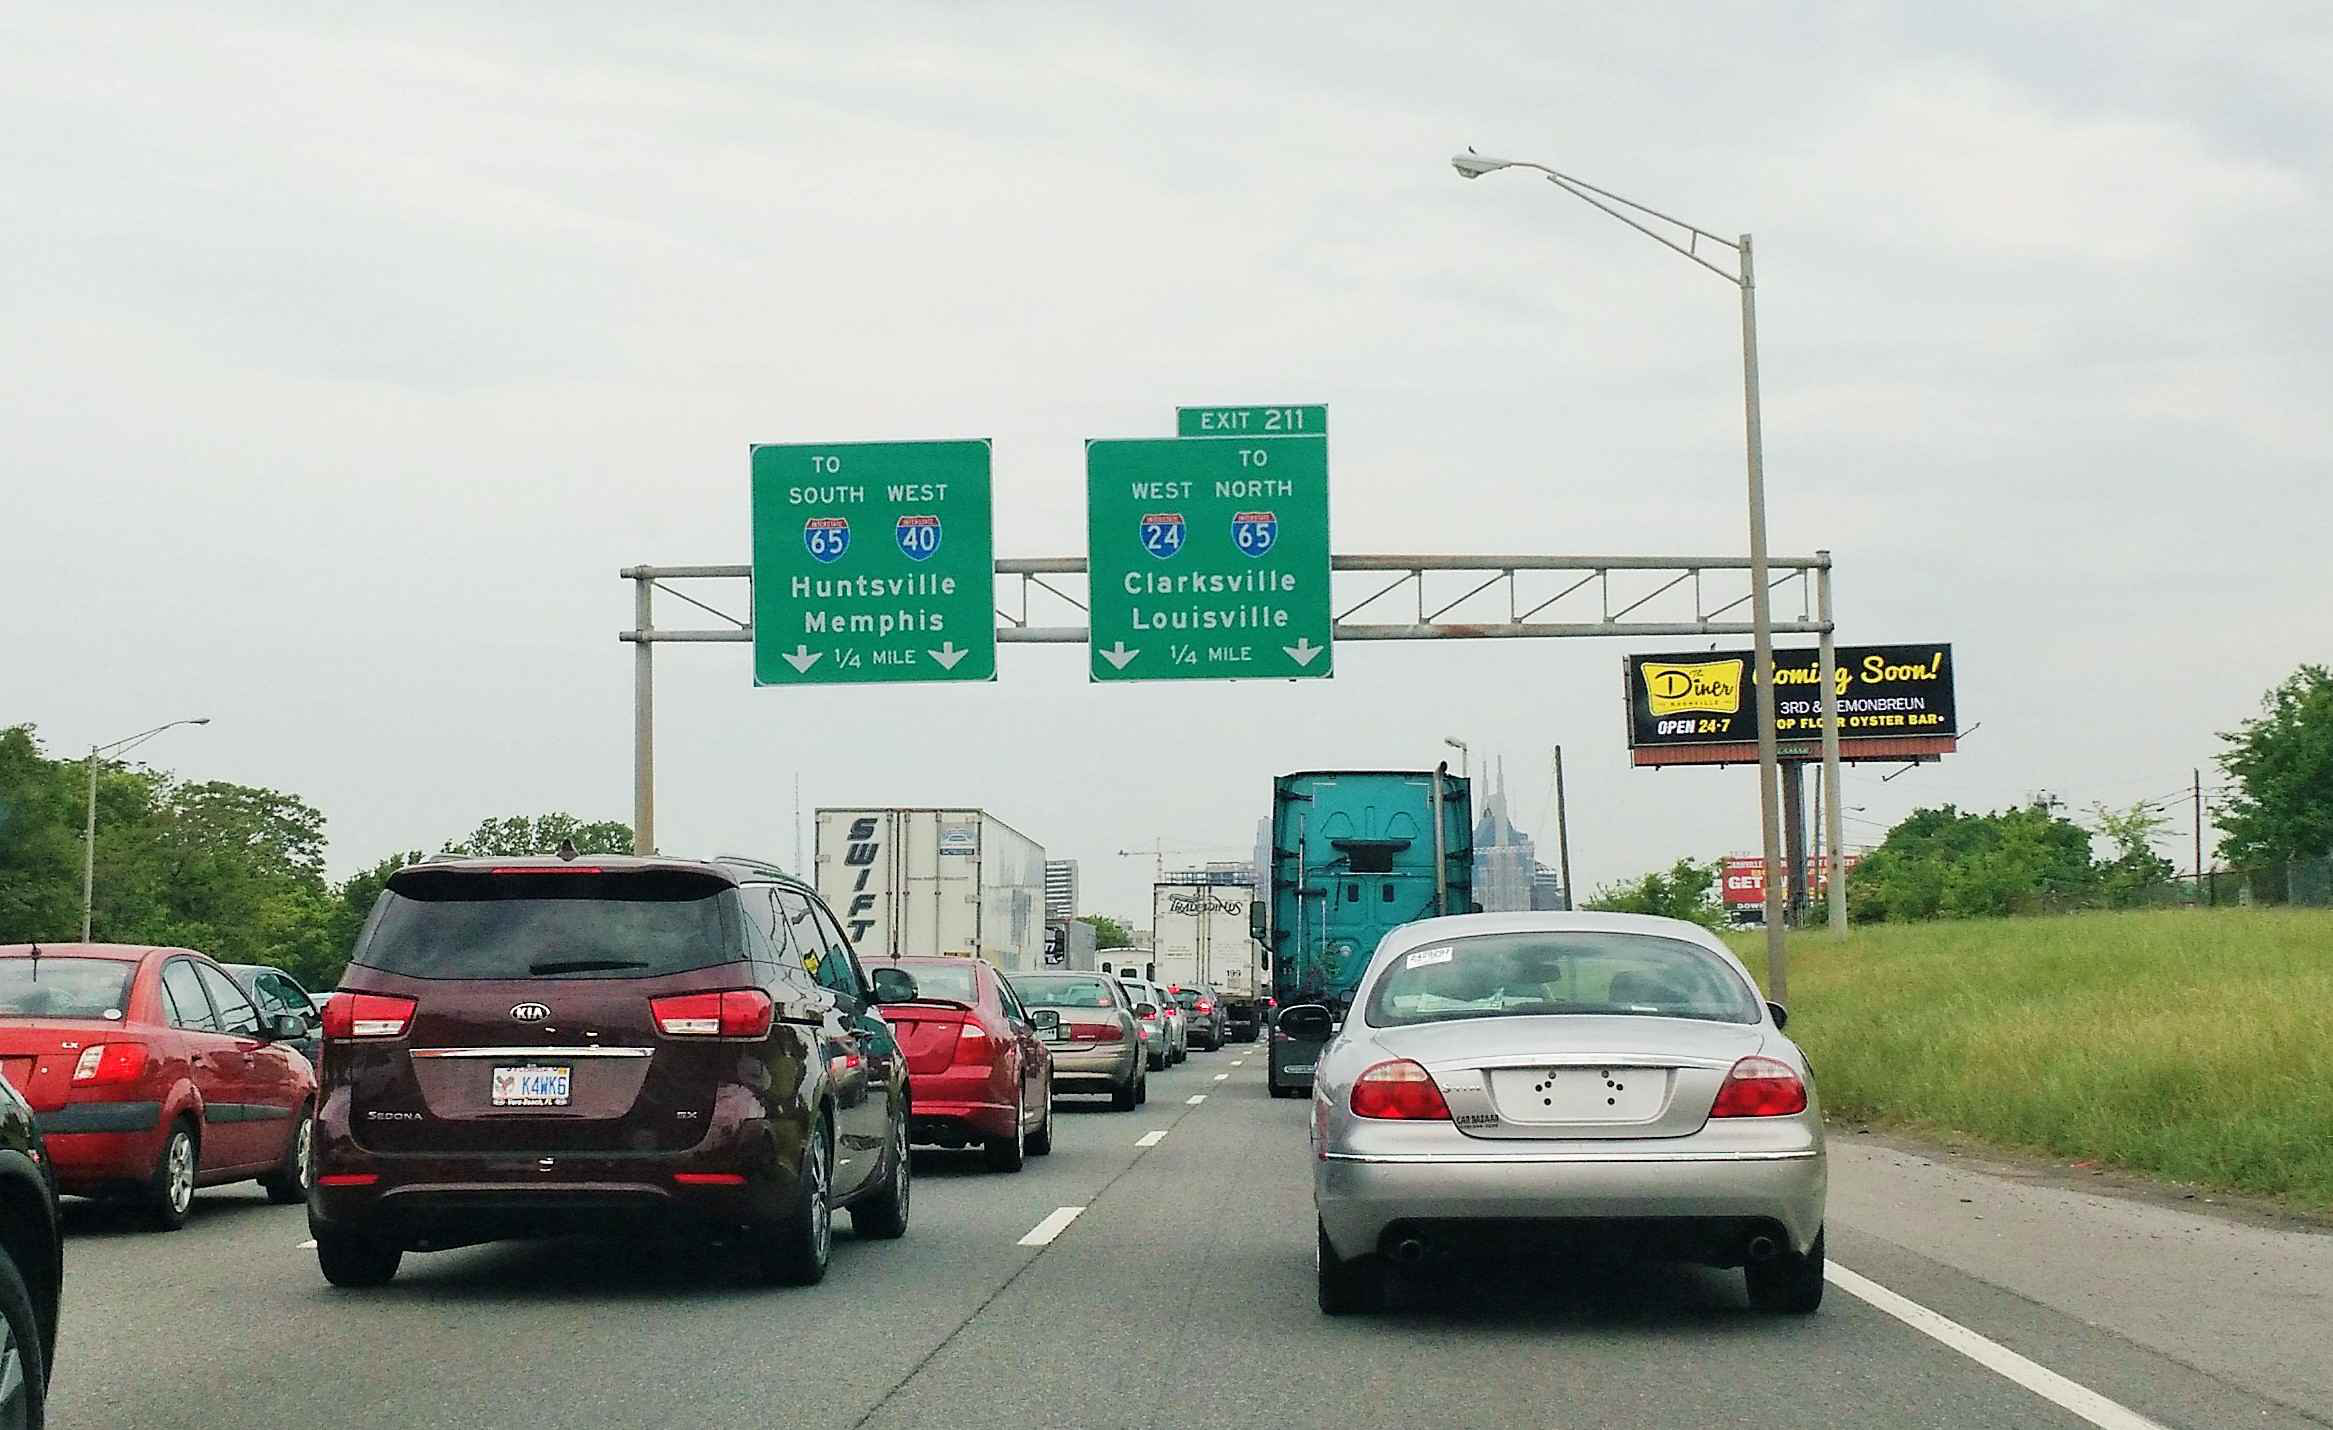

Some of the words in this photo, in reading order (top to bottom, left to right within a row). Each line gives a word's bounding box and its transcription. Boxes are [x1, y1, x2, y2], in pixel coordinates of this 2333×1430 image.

[1201, 412, 1250, 430] EXIT
[1264, 409, 1304, 430] 211
[812, 456, 841, 473] TO
[1238, 450, 1268, 467] TO
[789, 485, 865, 504] SOUTH
[887, 484, 948, 502] WEST
[1132, 481, 1192, 499] WEST
[1215, 480, 1293, 498] NORTH
[811, 529, 844, 554] 65
[903, 526, 935, 551] 40
[1147, 524, 1180, 550] 24
[1238, 523, 1271, 548] 65
[791, 574, 957, 598] Huntsville
[1123, 570, 1297, 595] Clarksville
[804, 608, 945, 637] Memphis
[1132, 606, 1289, 630] Louisville
[872, 650, 916, 665] MILE
[1208, 647, 1253, 662] MILE
[1861, 652, 1942, 684] Soon!
[1655, 670, 1734, 699] Diner
[1780, 701, 1810, 715] 3RD
[1836, 697, 1926, 713] EMONBREUN
[1657, 720, 1696, 735] OPEN
[1776, 717, 1796, 730] OP
[1800, 716, 1846, 729] FLOR
[1850, 715, 1904, 728] OYSTER
[844, 817, 879, 943] SWIFT
[1728, 875, 1763, 890] GET
[516, 1006, 543, 1019] KIA
[368, 1111, 424, 1120] SEDONA
